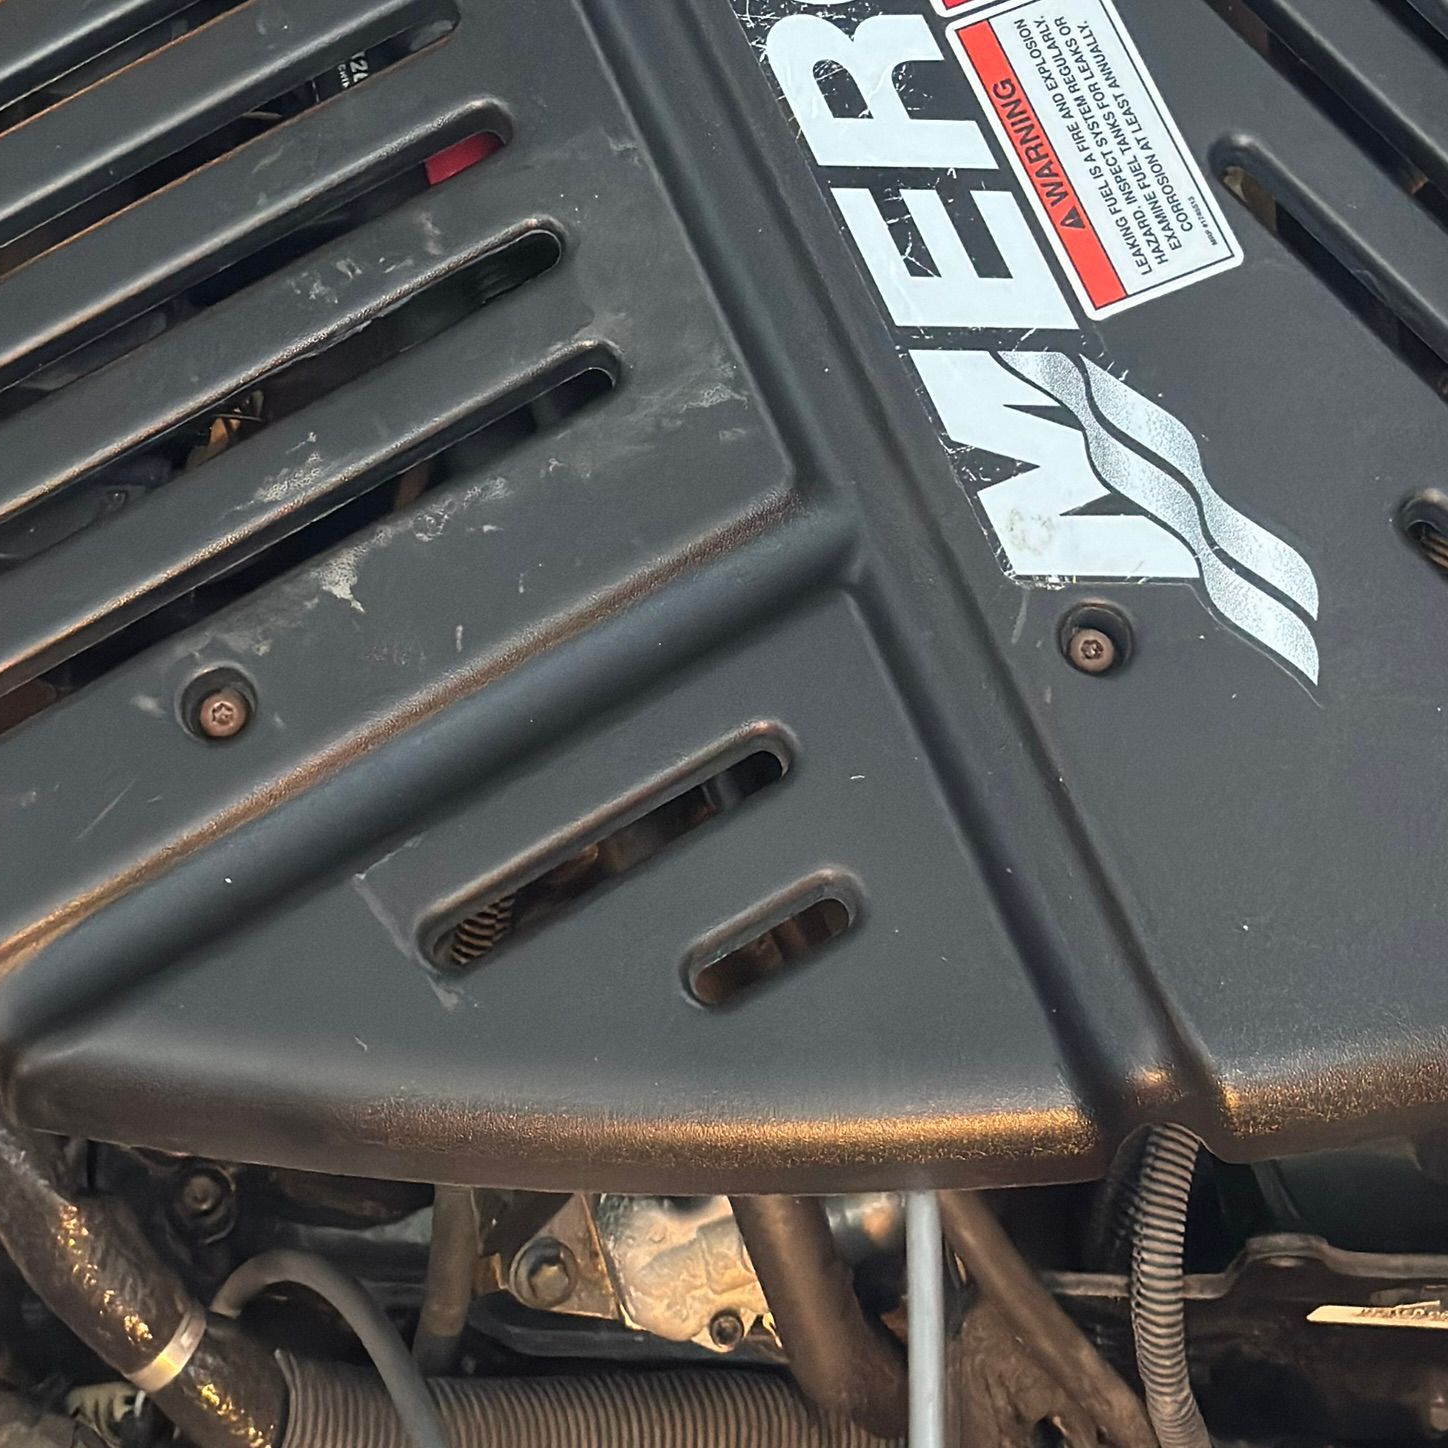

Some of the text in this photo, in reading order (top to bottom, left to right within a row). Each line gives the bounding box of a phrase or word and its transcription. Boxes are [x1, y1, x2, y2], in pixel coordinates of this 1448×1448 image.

[989, 75, 1071, 207] WARNING
[1013, 16, 1153, 276] LEAKING FUEL IS A FIRE AND EXPLOSION
[1032, 14, 1168, 265] HAZARD. INSPECT SYSTEM REGULARLY.
[1053, 14, 1182, 251] EXAMINE FUEL TANKS FOR LEAKS OR
[1076, 19, 1194, 233] CORROSION AT LEAST ANNUALLY.
